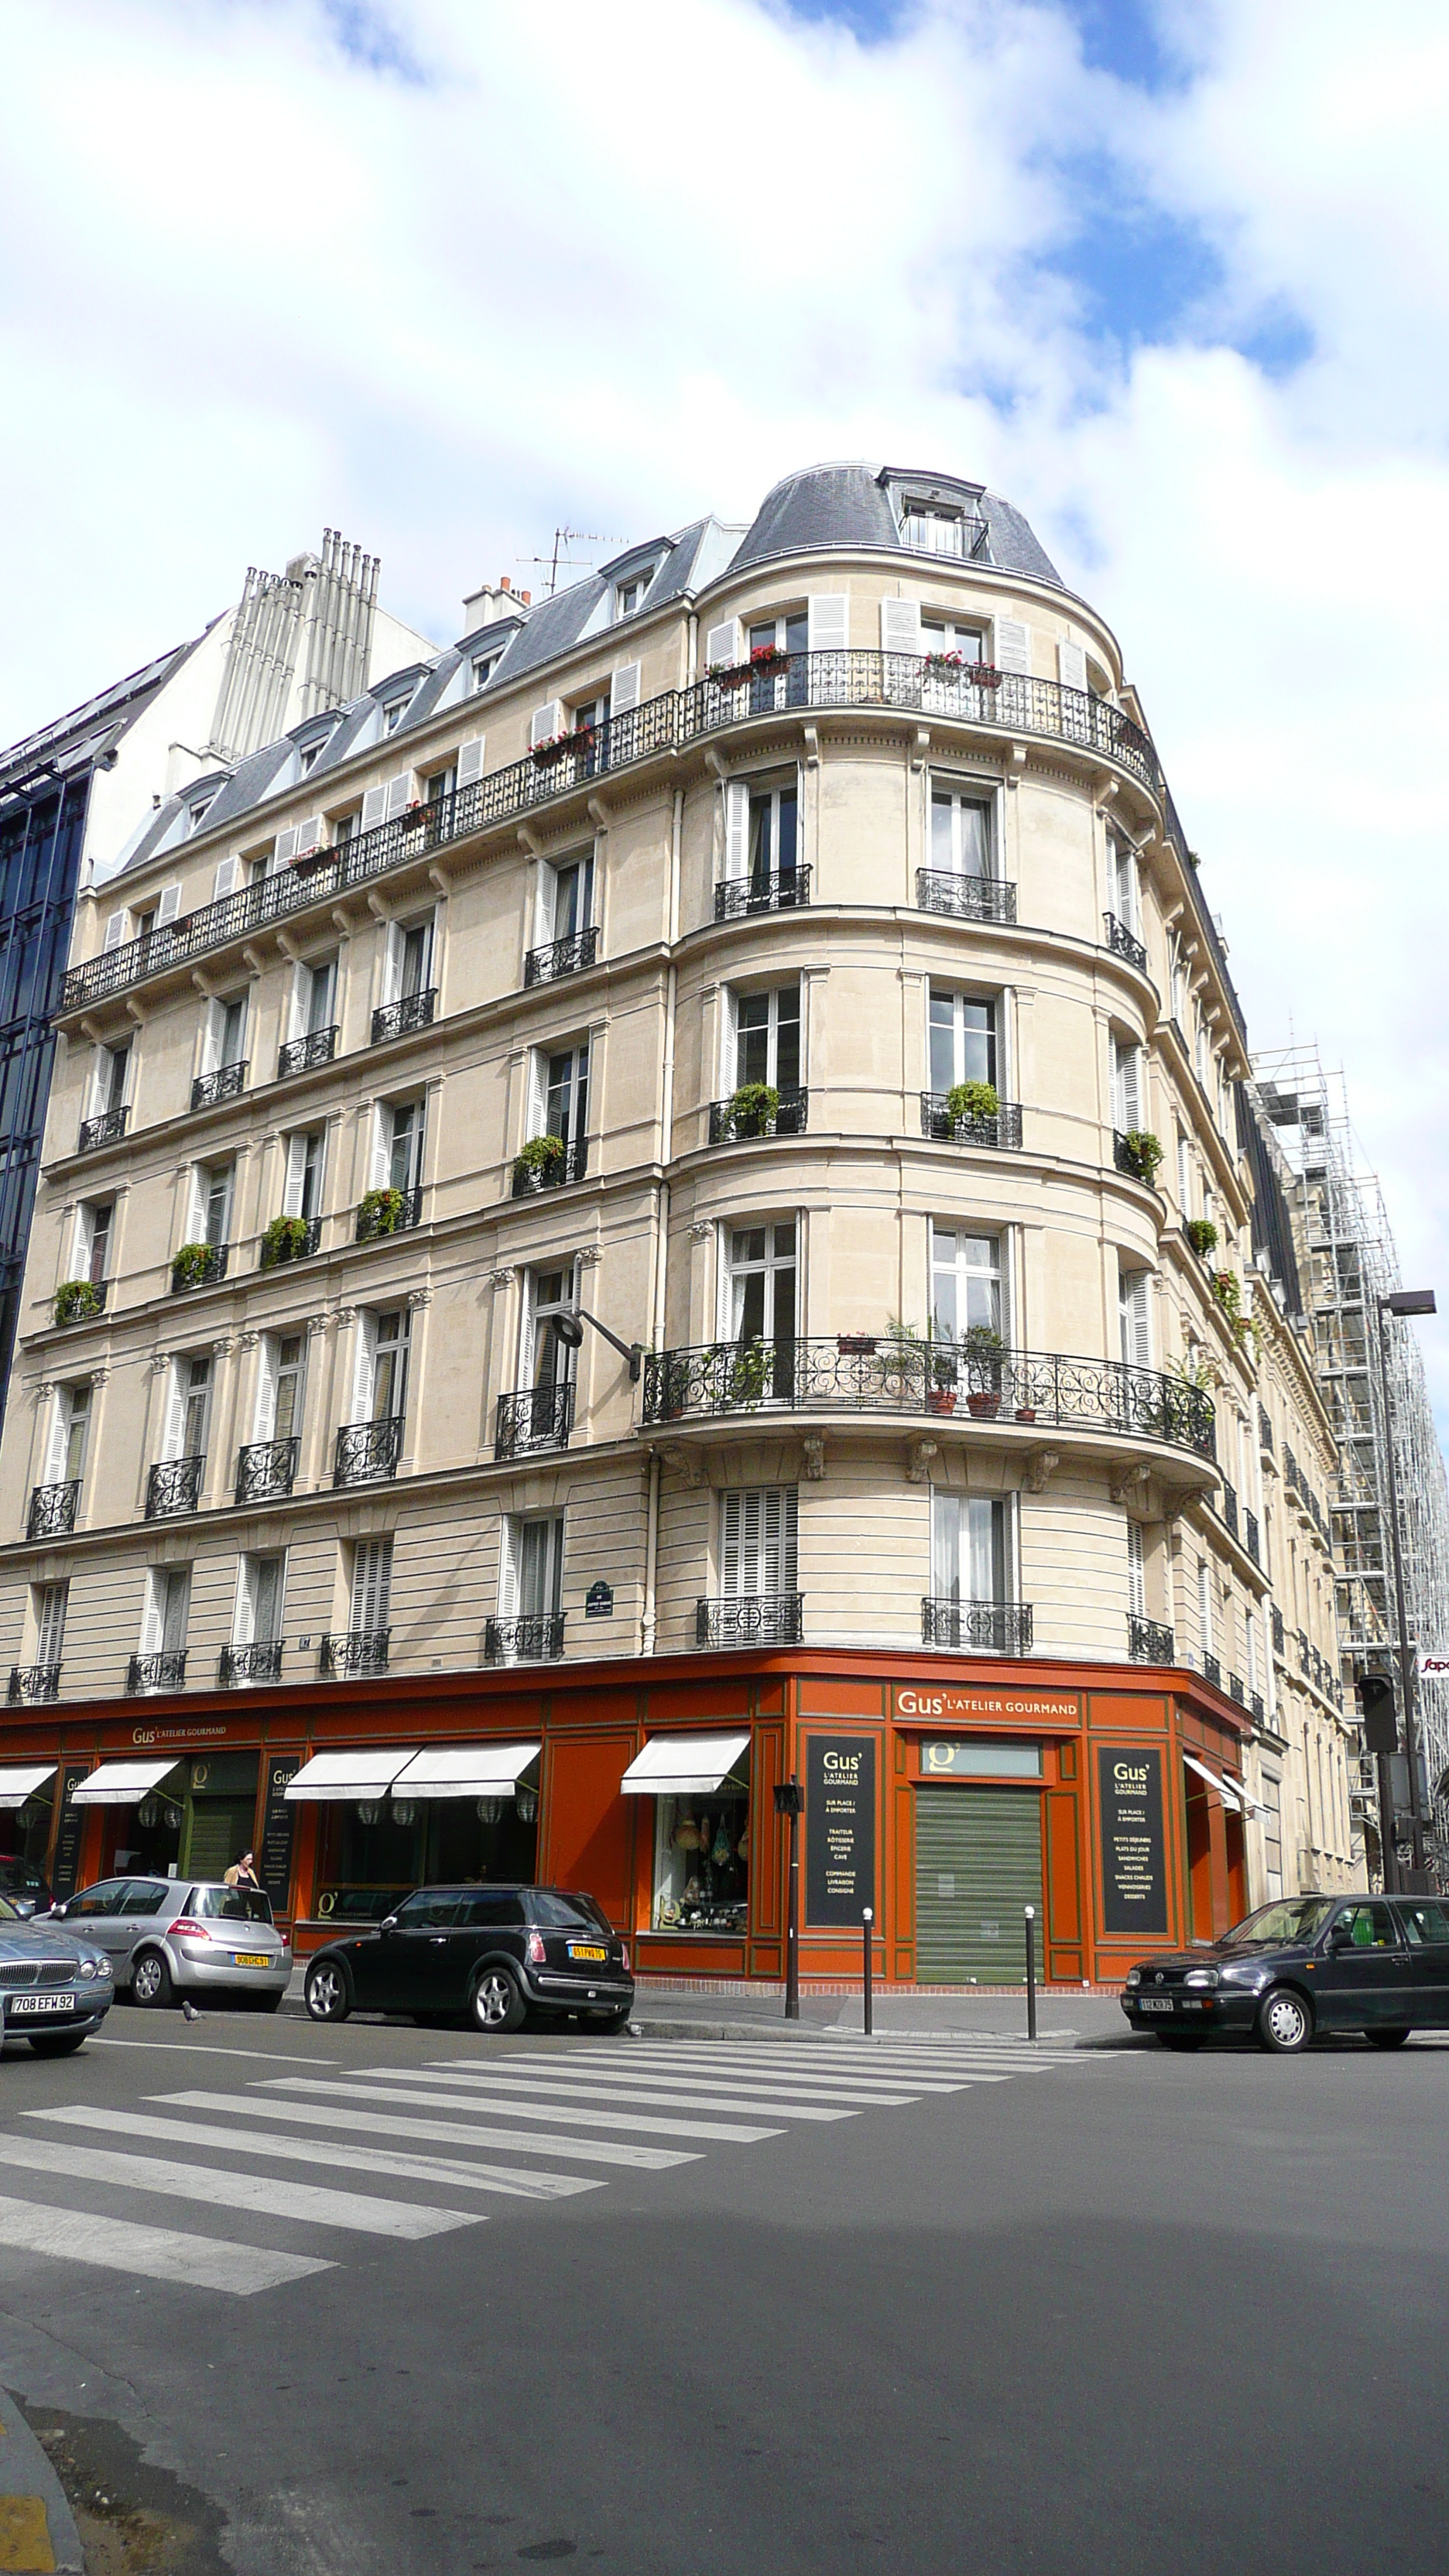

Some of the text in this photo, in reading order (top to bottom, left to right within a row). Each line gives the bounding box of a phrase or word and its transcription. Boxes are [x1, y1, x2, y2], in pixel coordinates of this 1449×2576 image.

[898, 1691, 1077, 1716] Gus' L'ATELIER GOURMAND
[187, 1726, 226, 1736] GOURMAND
[823, 1752, 862, 1770] Gus'
[1113, 1762, 1150, 1781] Gus'
[16, 1995, 73, 2011] 708 EFW 92
